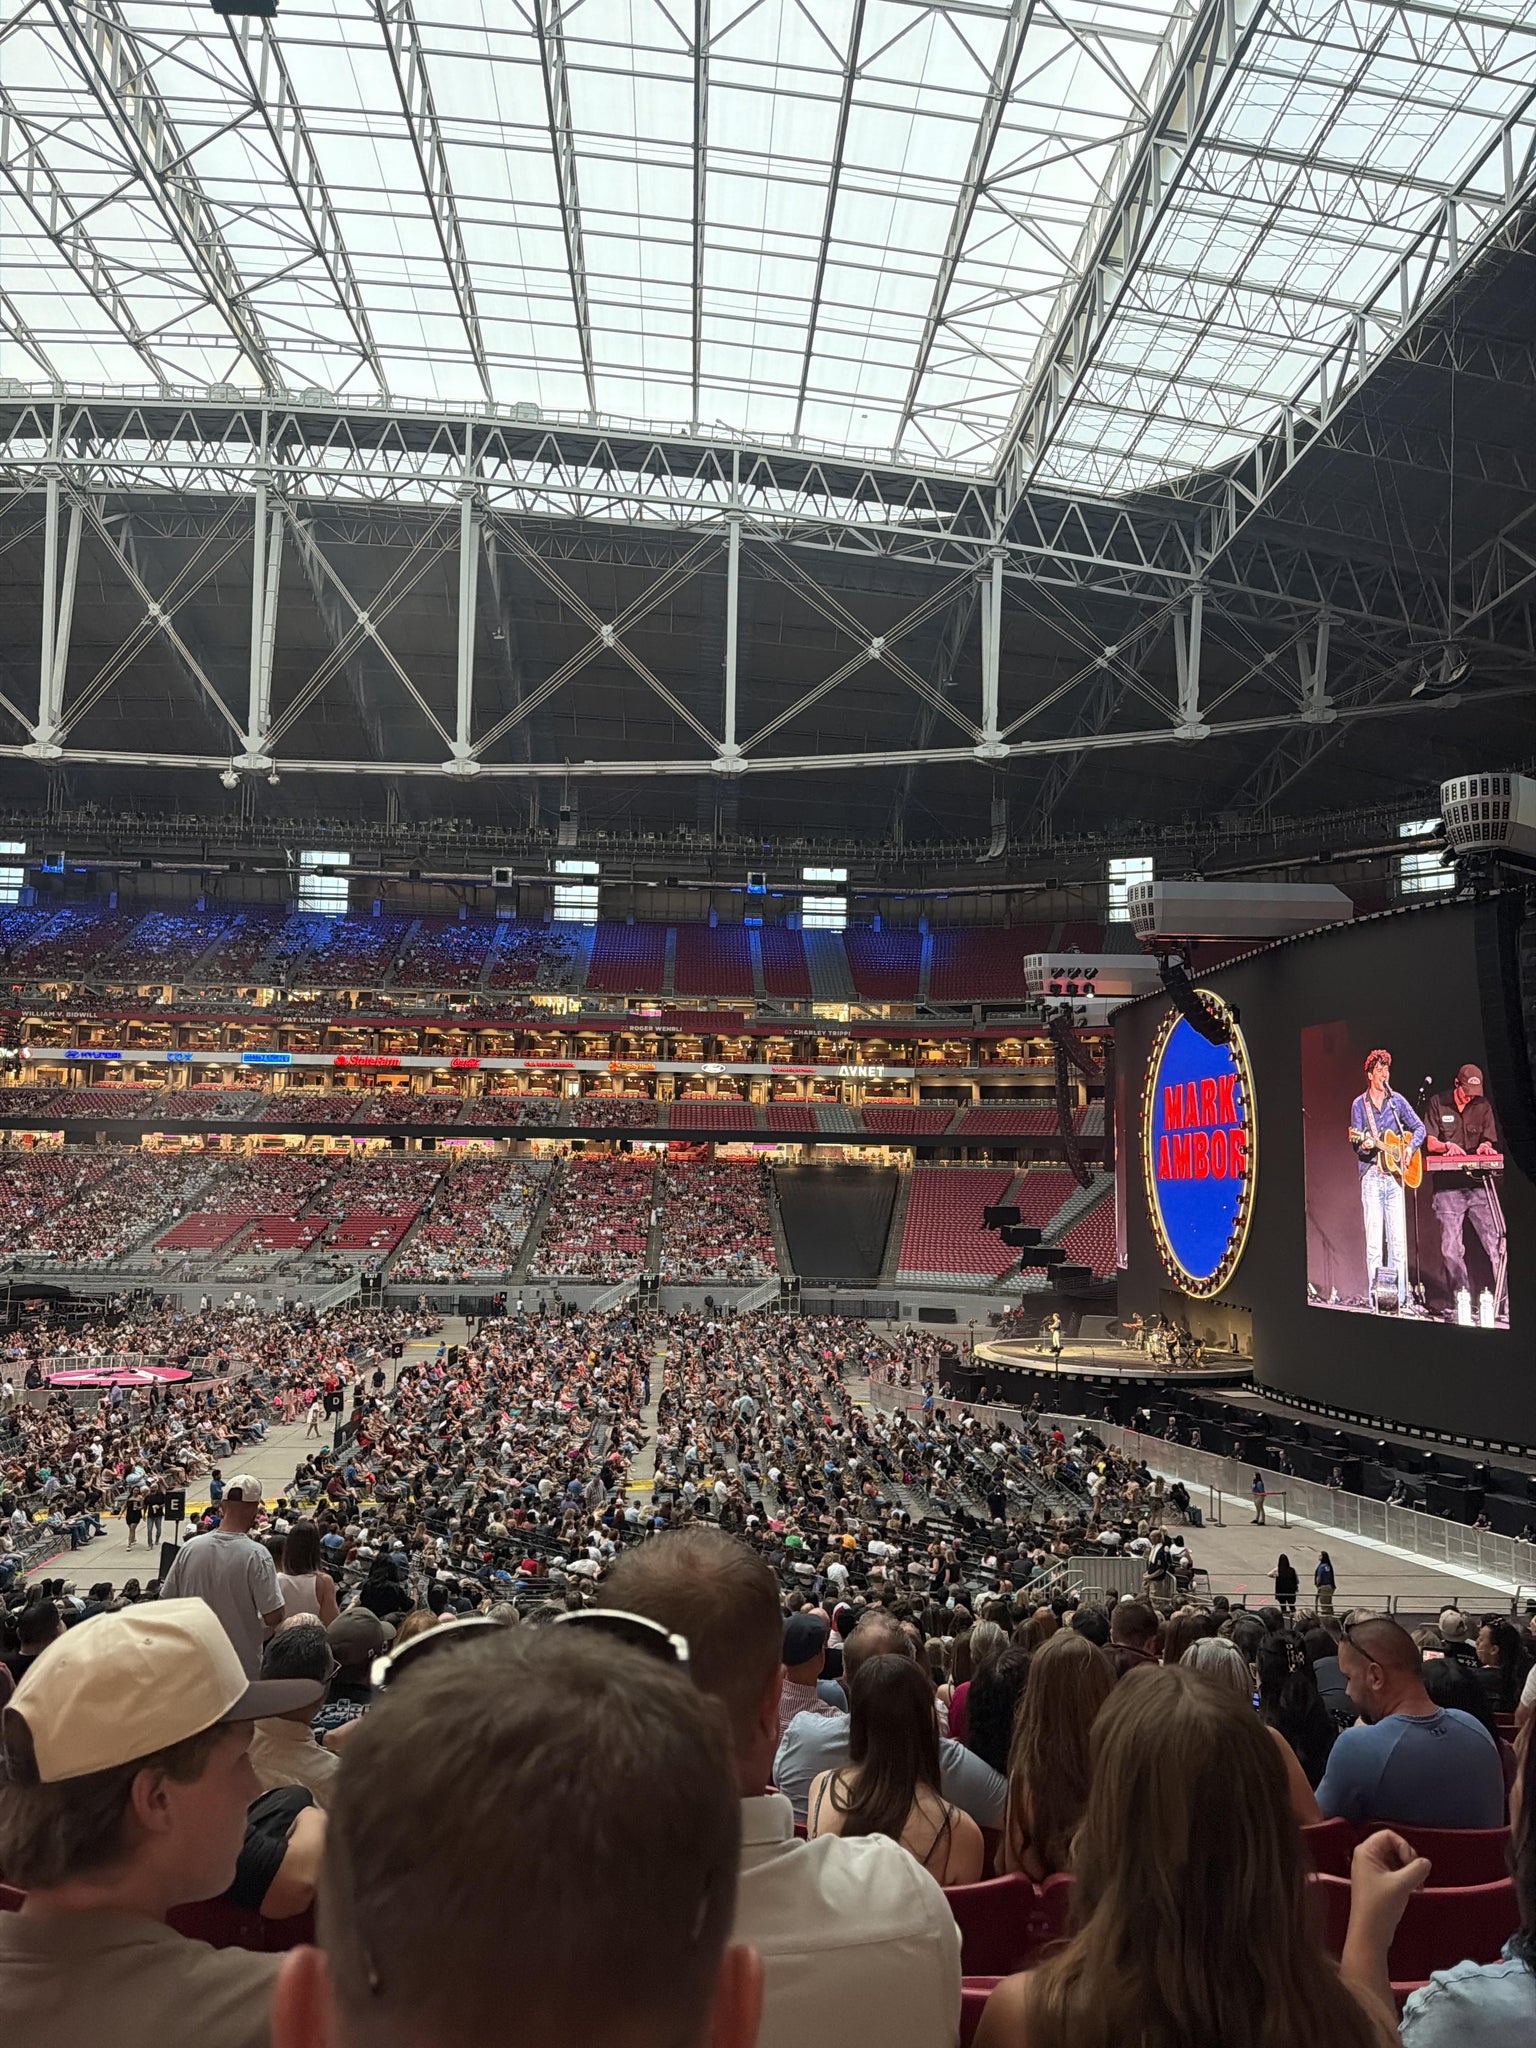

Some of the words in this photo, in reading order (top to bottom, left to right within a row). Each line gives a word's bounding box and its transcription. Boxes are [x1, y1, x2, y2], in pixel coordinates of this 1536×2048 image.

[839, 1066, 885, 1077] AVNET
[1163, 1073, 1237, 1131] MARK
[1157, 1129, 1246, 1181] AMBOR
[332, 1396, 340, 1406] D
[170, 1499, 179, 1511] E
